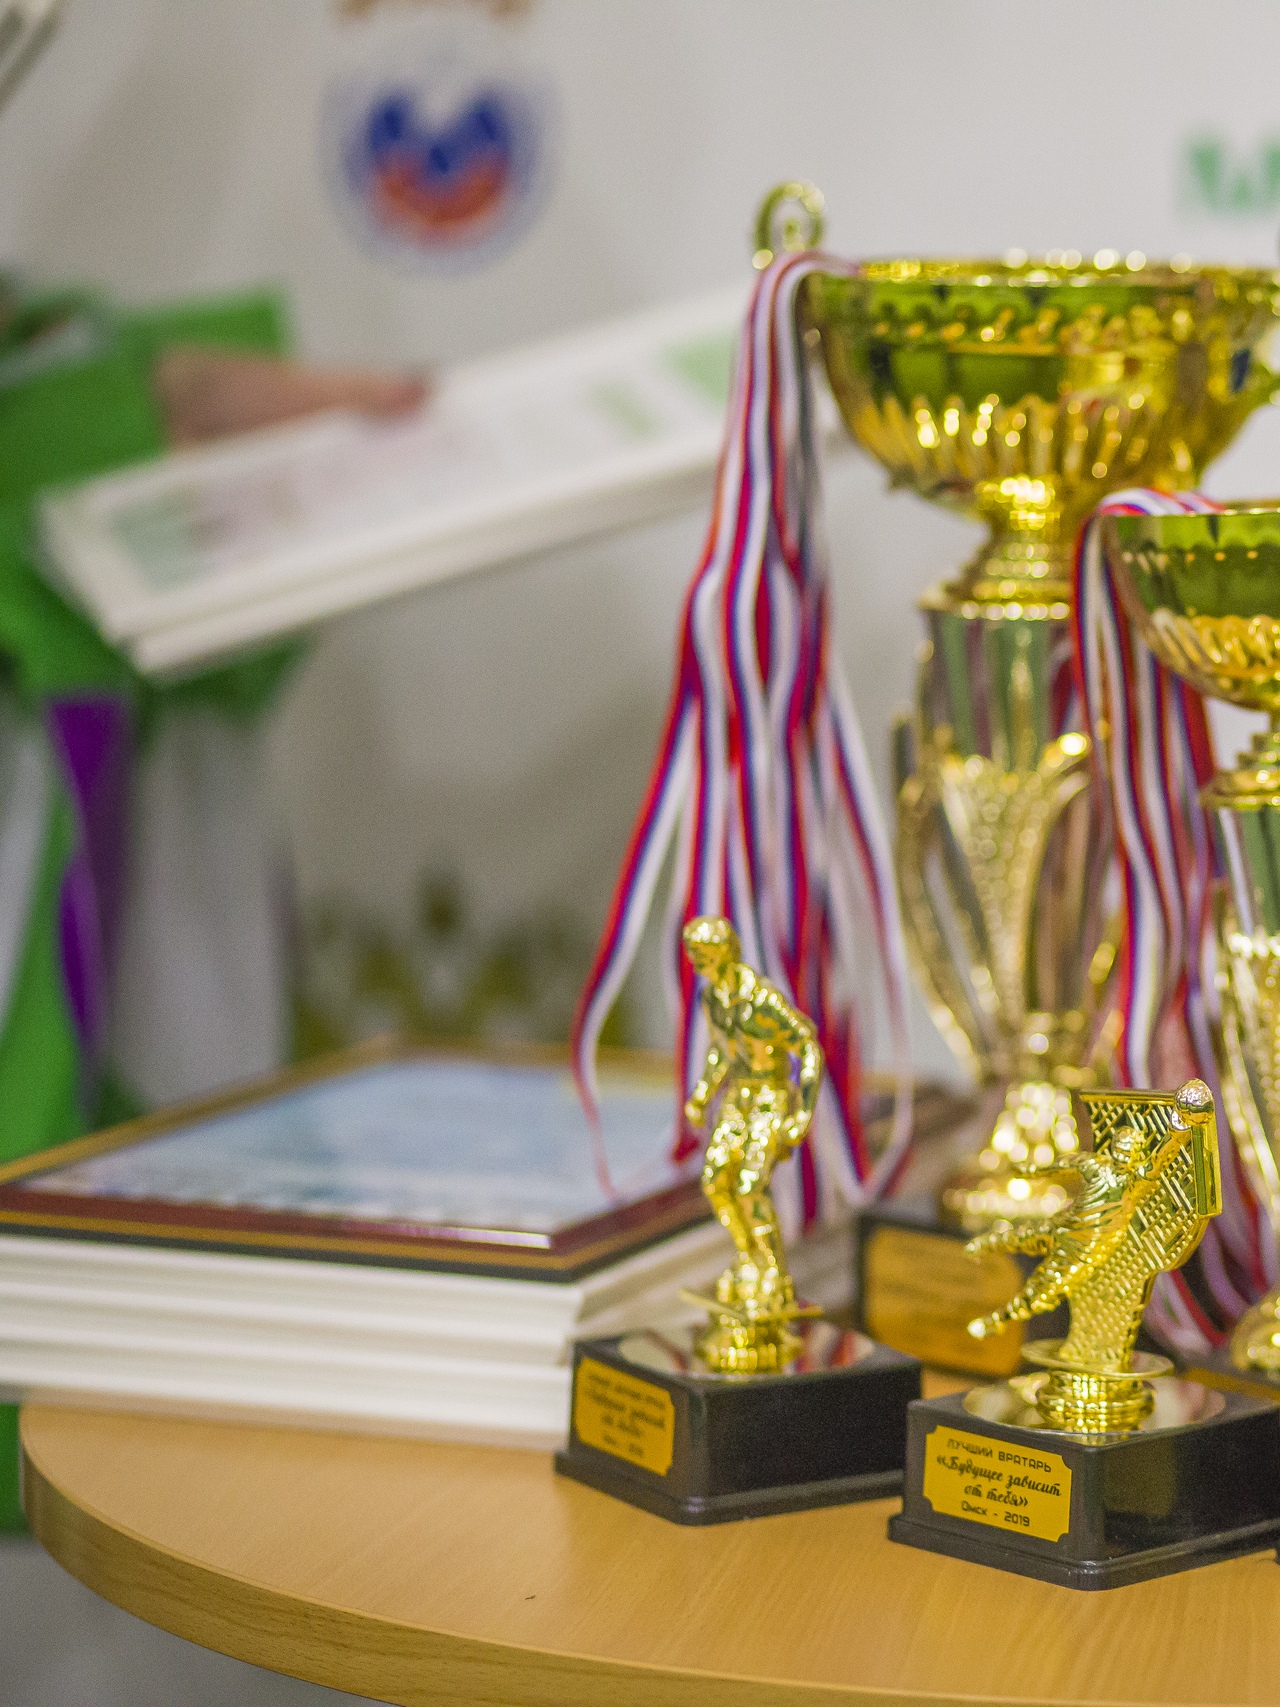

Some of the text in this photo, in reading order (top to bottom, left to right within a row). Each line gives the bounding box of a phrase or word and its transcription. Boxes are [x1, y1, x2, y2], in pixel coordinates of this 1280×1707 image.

[998, 1451, 1052, 1473] ВРАТАРЬ
[964, 1484, 1029, 1507] от тебя»
[1006, 1474, 1061, 1497] зависит
[961, 1501, 988, 1517] Омск
[1004, 1511, 1030, 1527] 2019
